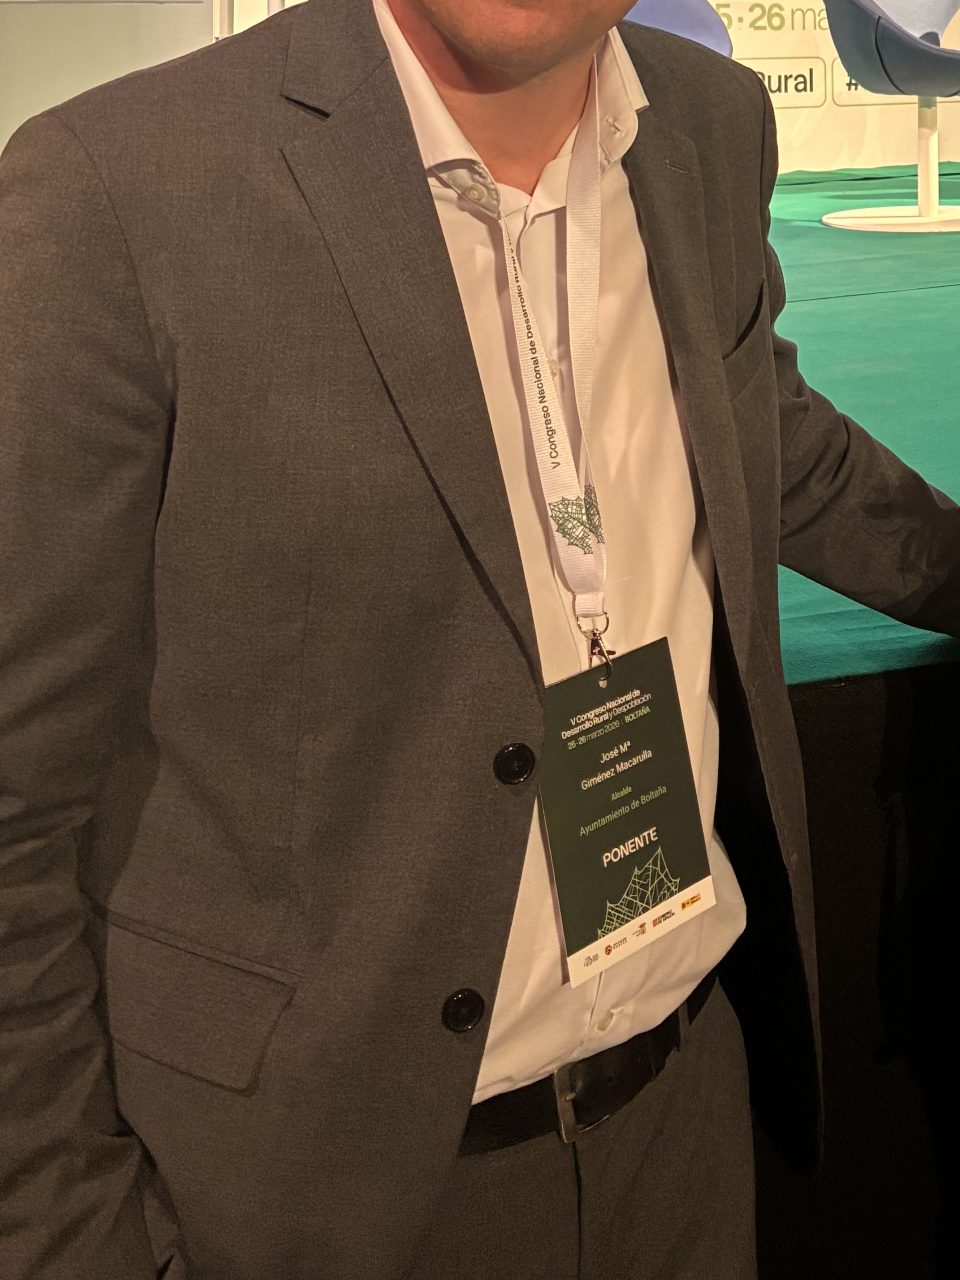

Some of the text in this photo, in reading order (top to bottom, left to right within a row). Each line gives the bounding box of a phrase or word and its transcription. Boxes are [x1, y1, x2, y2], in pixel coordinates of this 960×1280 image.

[715, 3, 734, 30] 5
[748, 3, 786, 31] 26
[516, 285, 534, 340] Desarrollo
[529, 341, 537, 355] de
[533, 356, 548, 404] Nacional
[541, 405, 559, 459] Congreso
[551, 461, 561, 470] V
[561, 721, 594, 740] Desarrollo
[612, 693, 652, 716] Despoblación
[570, 717, 577, 726] V
[576, 704, 607, 724] Congreso
[581, 749, 653, 791] Giménez Macarulla
[600, 740, 631, 764] José Mª
[580, 785, 667, 837] Ayuntamiento de Boltaña
[611, 785, 632, 802] Alcalde
[602, 826, 659, 868] PONENTE
